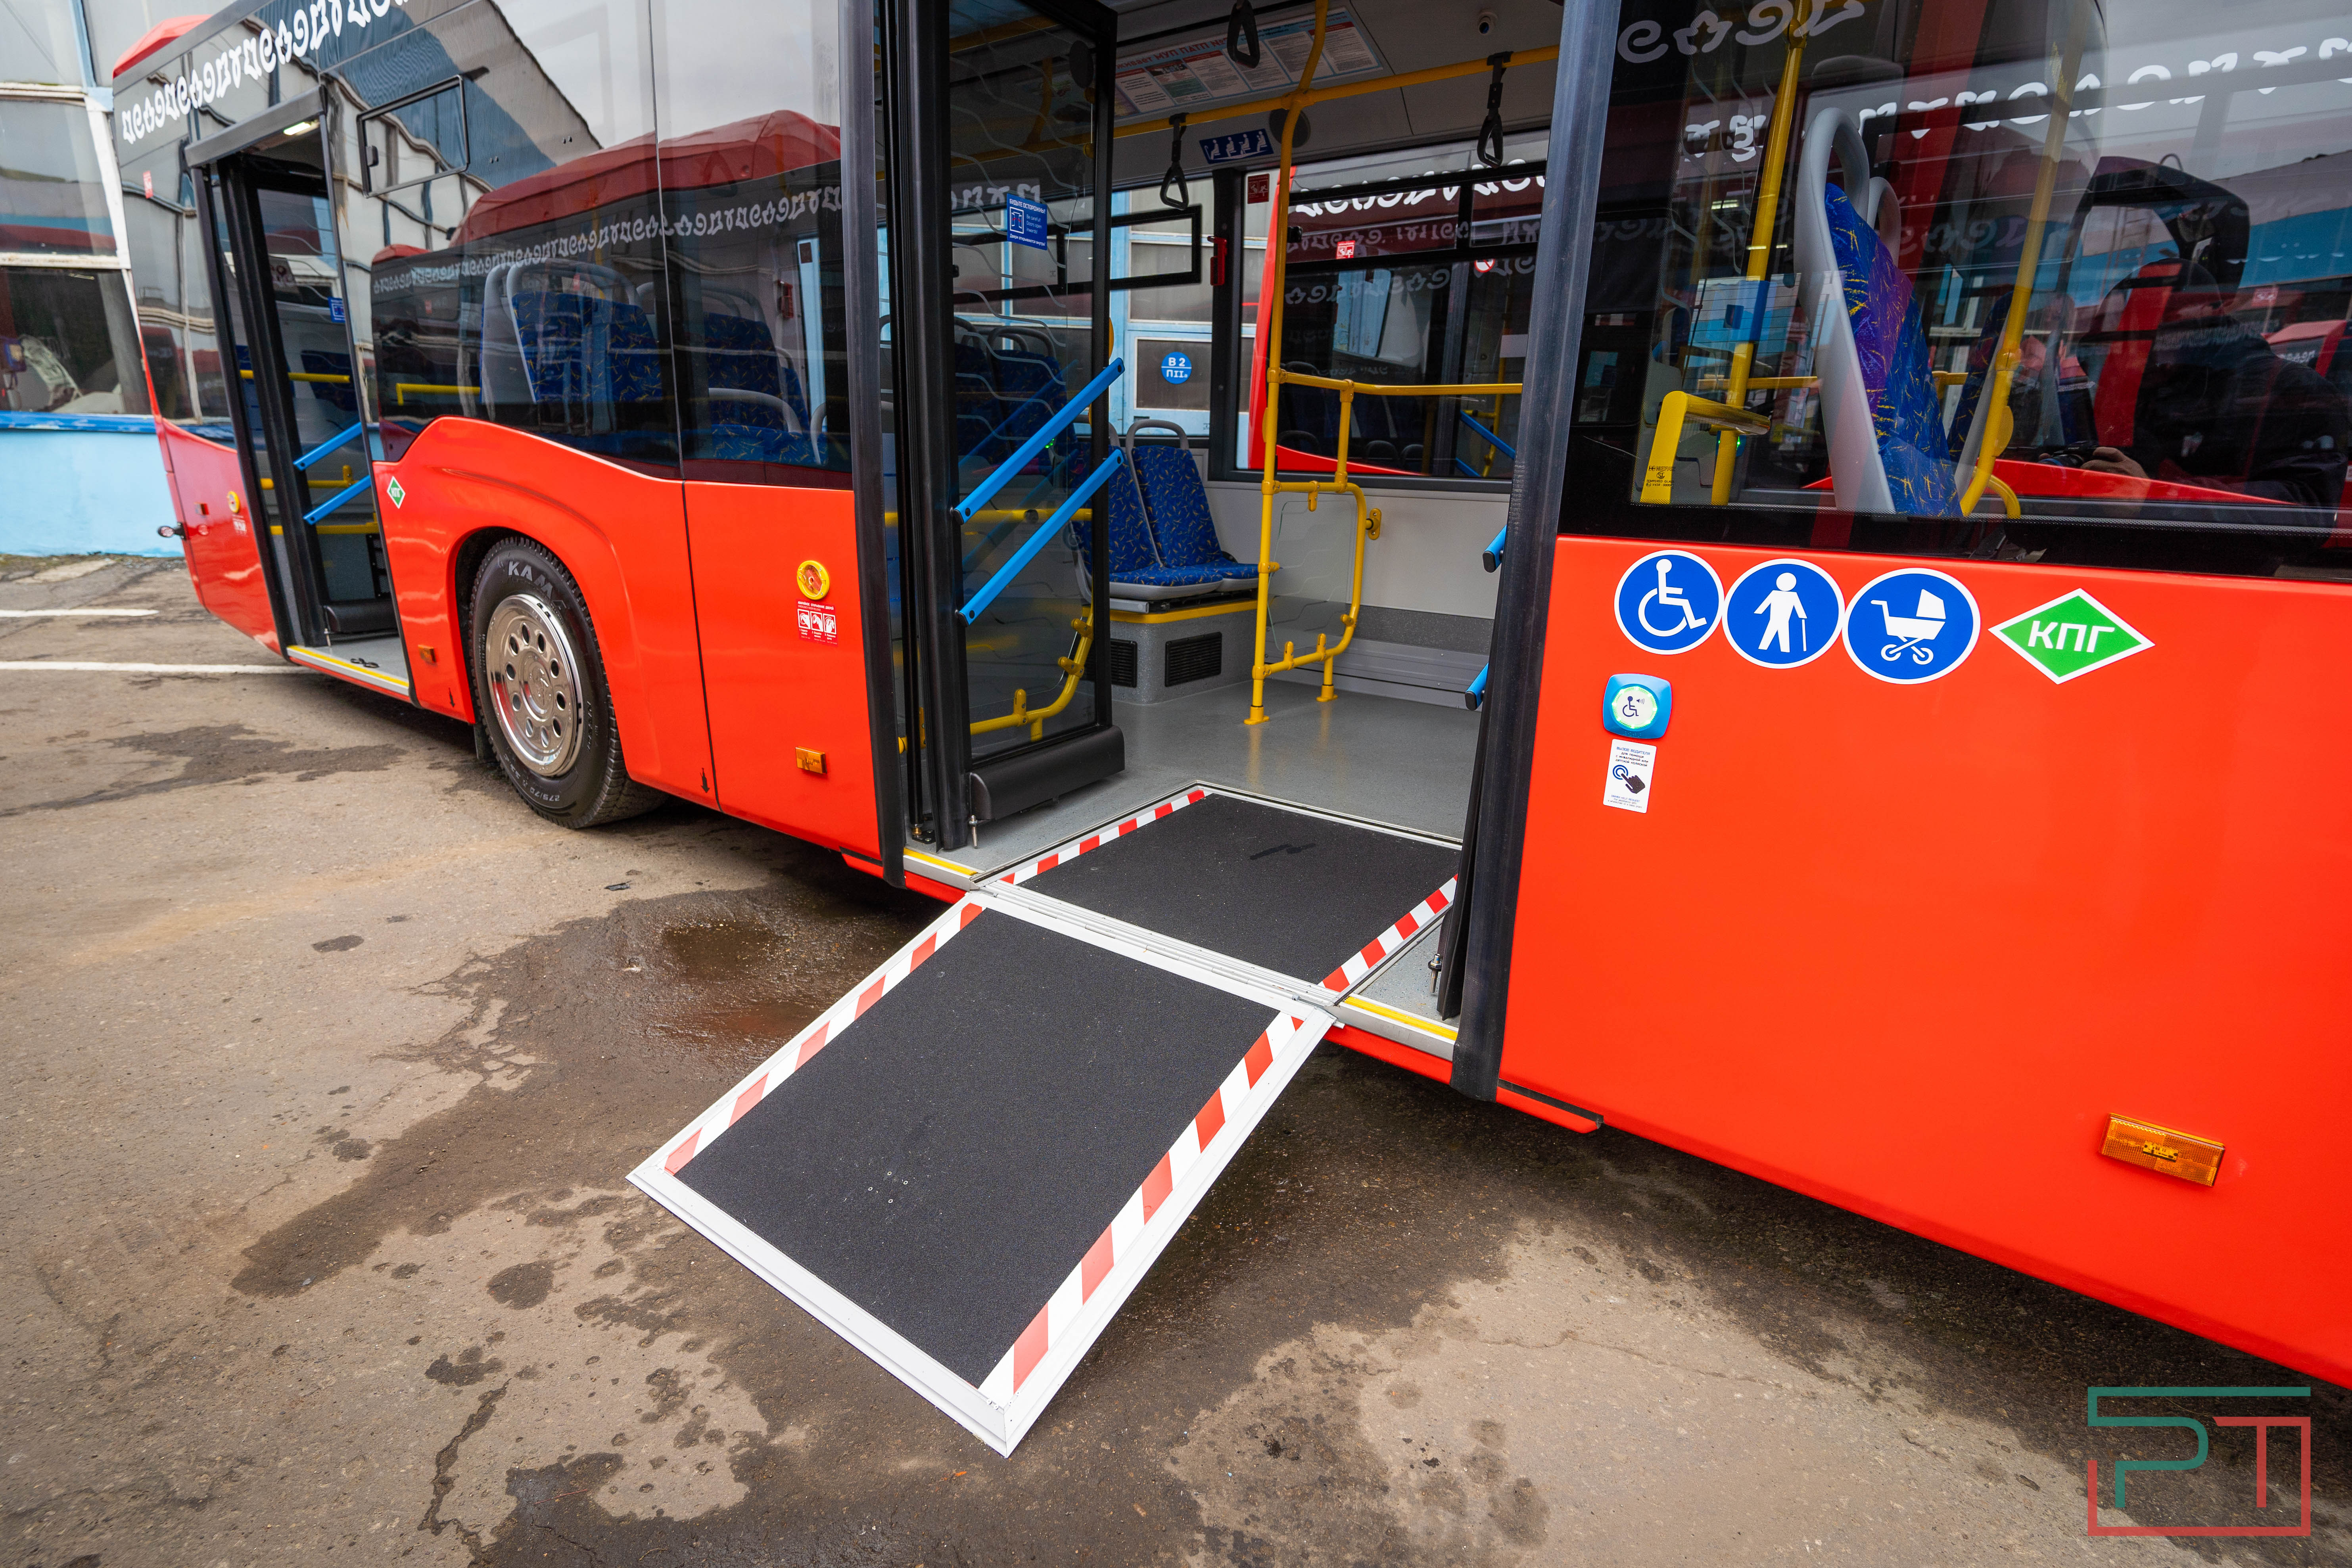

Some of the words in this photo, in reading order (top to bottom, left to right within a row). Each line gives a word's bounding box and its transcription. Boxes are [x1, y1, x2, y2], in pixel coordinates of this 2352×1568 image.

[1117, 56, 1152, 69] живает
[1009, 199, 1023, 207] БУДЬТЕ
[2028, 620, 2115, 653] КПГ
[529, 787, 560, 802] 275/70
